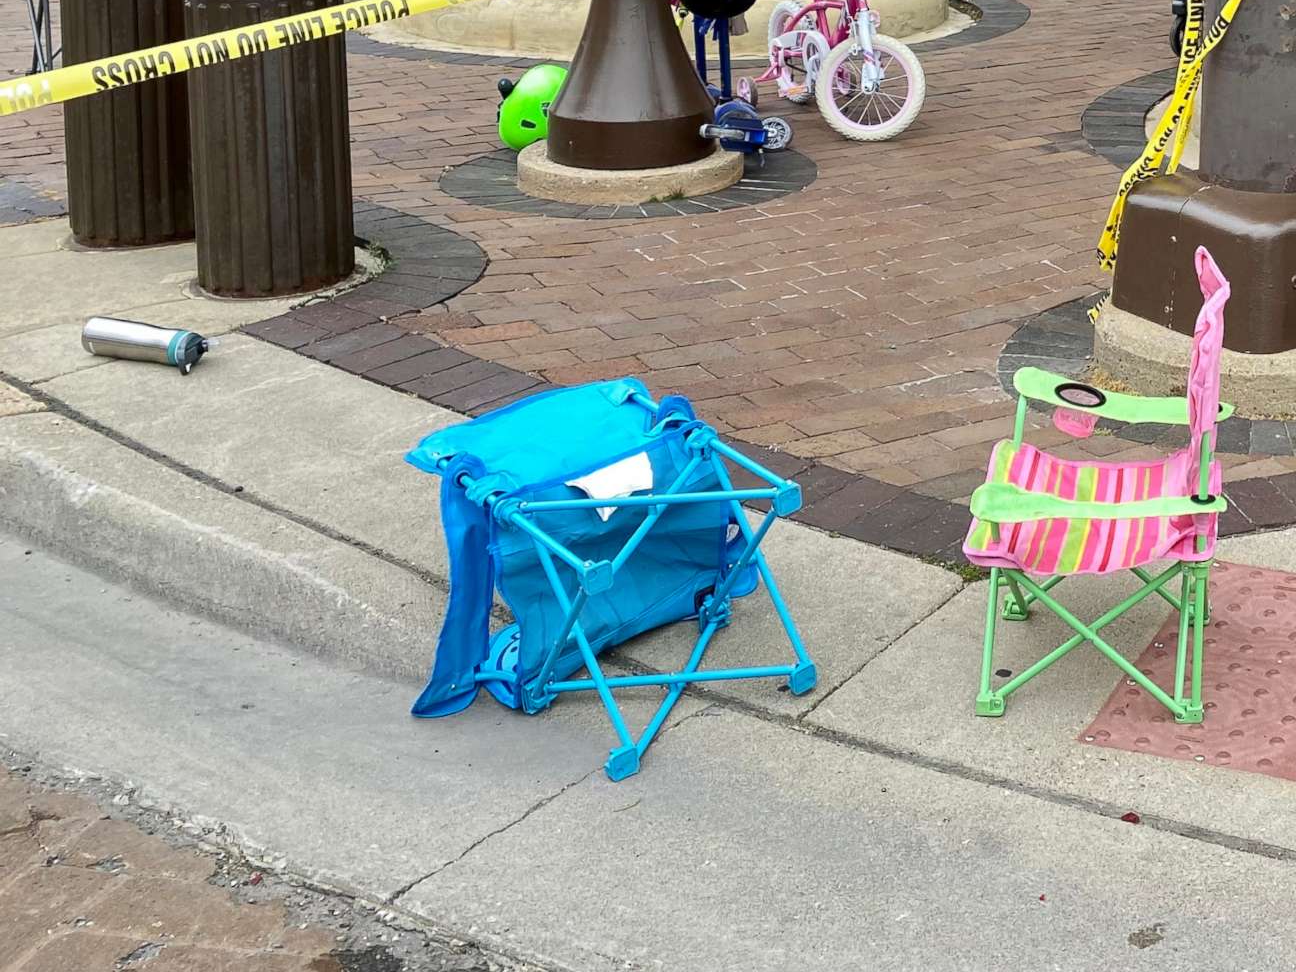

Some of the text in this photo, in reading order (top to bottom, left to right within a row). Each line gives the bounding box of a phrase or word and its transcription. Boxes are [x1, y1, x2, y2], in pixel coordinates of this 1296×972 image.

[236, 28, 270, 57] DO
[275, 15, 329, 49] LINE
[184, 36, 230, 69] NOT
[91, 50, 176, 93] CROSS
